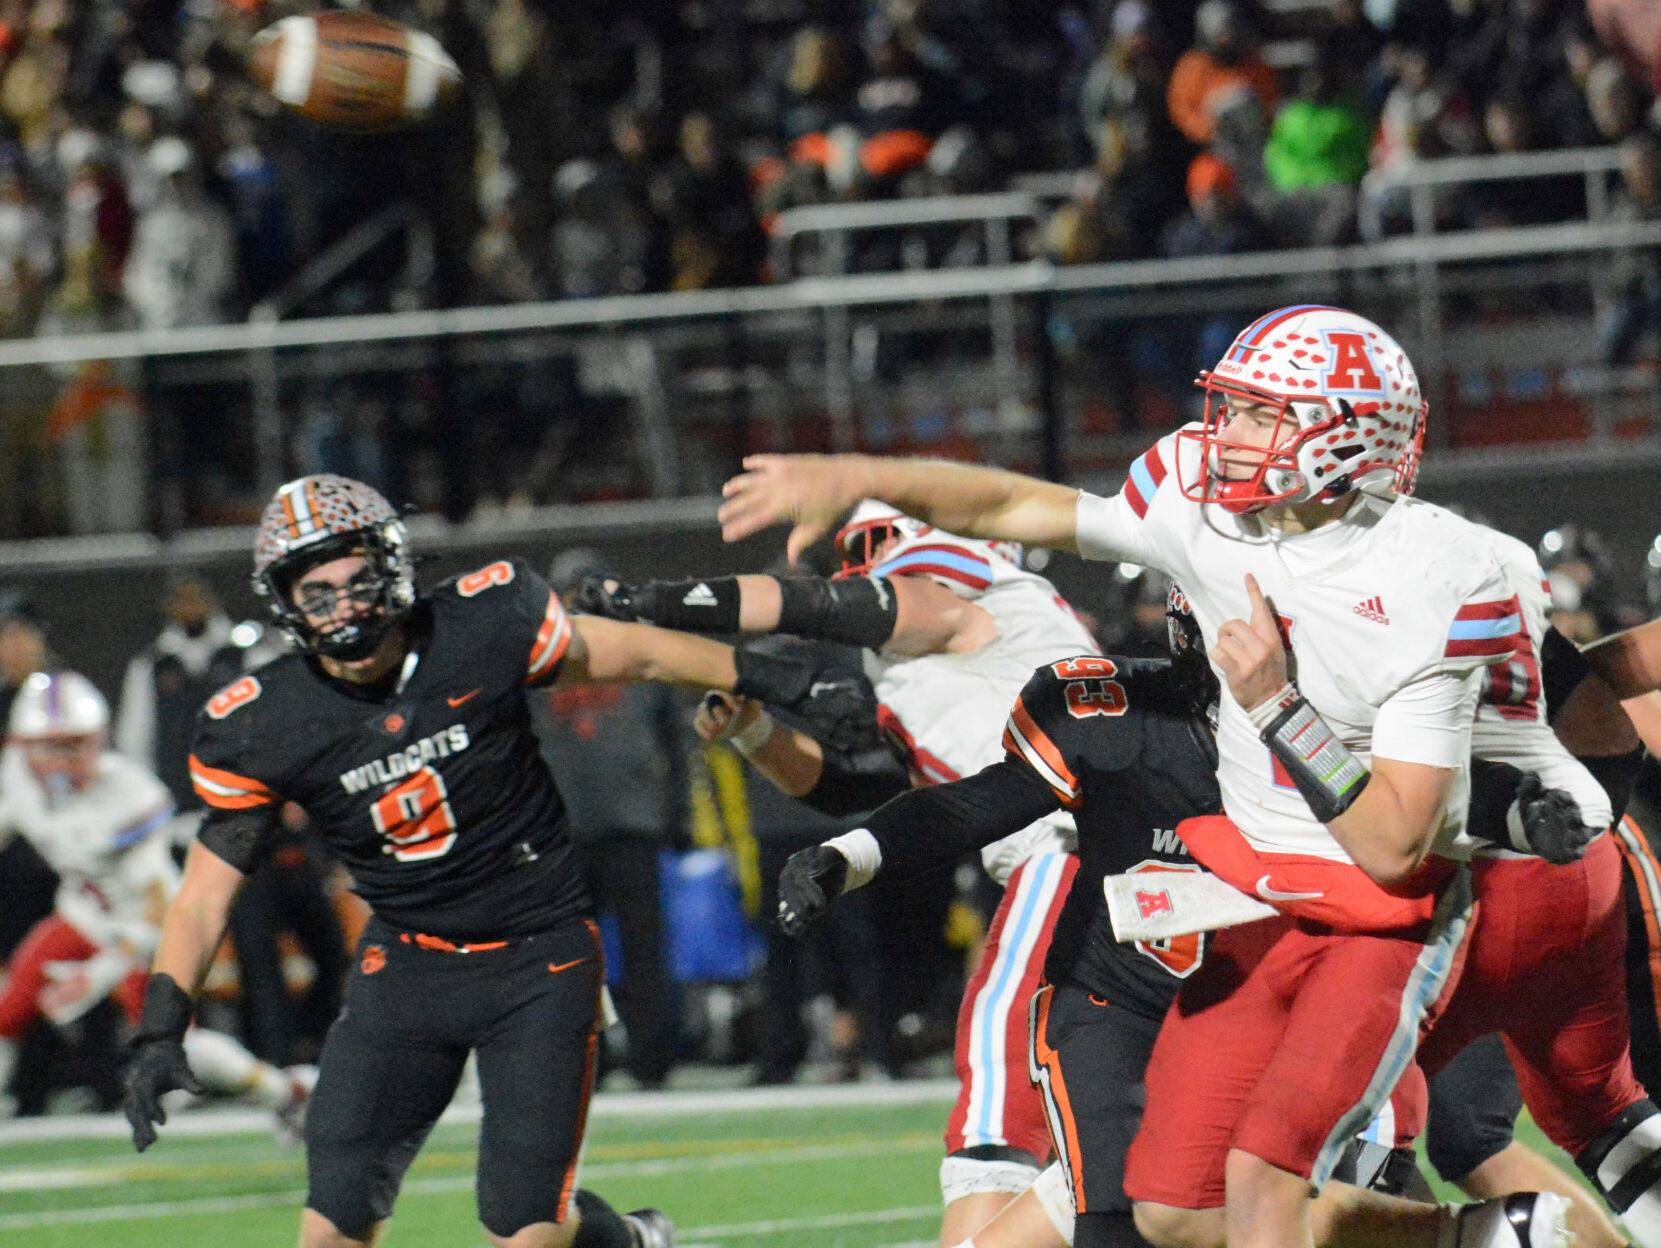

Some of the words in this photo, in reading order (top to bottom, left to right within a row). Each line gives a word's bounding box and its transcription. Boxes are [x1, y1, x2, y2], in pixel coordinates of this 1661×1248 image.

[1322, 330, 1385, 395] A
[1353, 606, 1390, 626] adidas
[1051, 657, 1129, 719] 93
[339, 723, 470, 794] WILDCATS
[370, 766, 458, 863] 9
[1134, 887, 1174, 920] A
